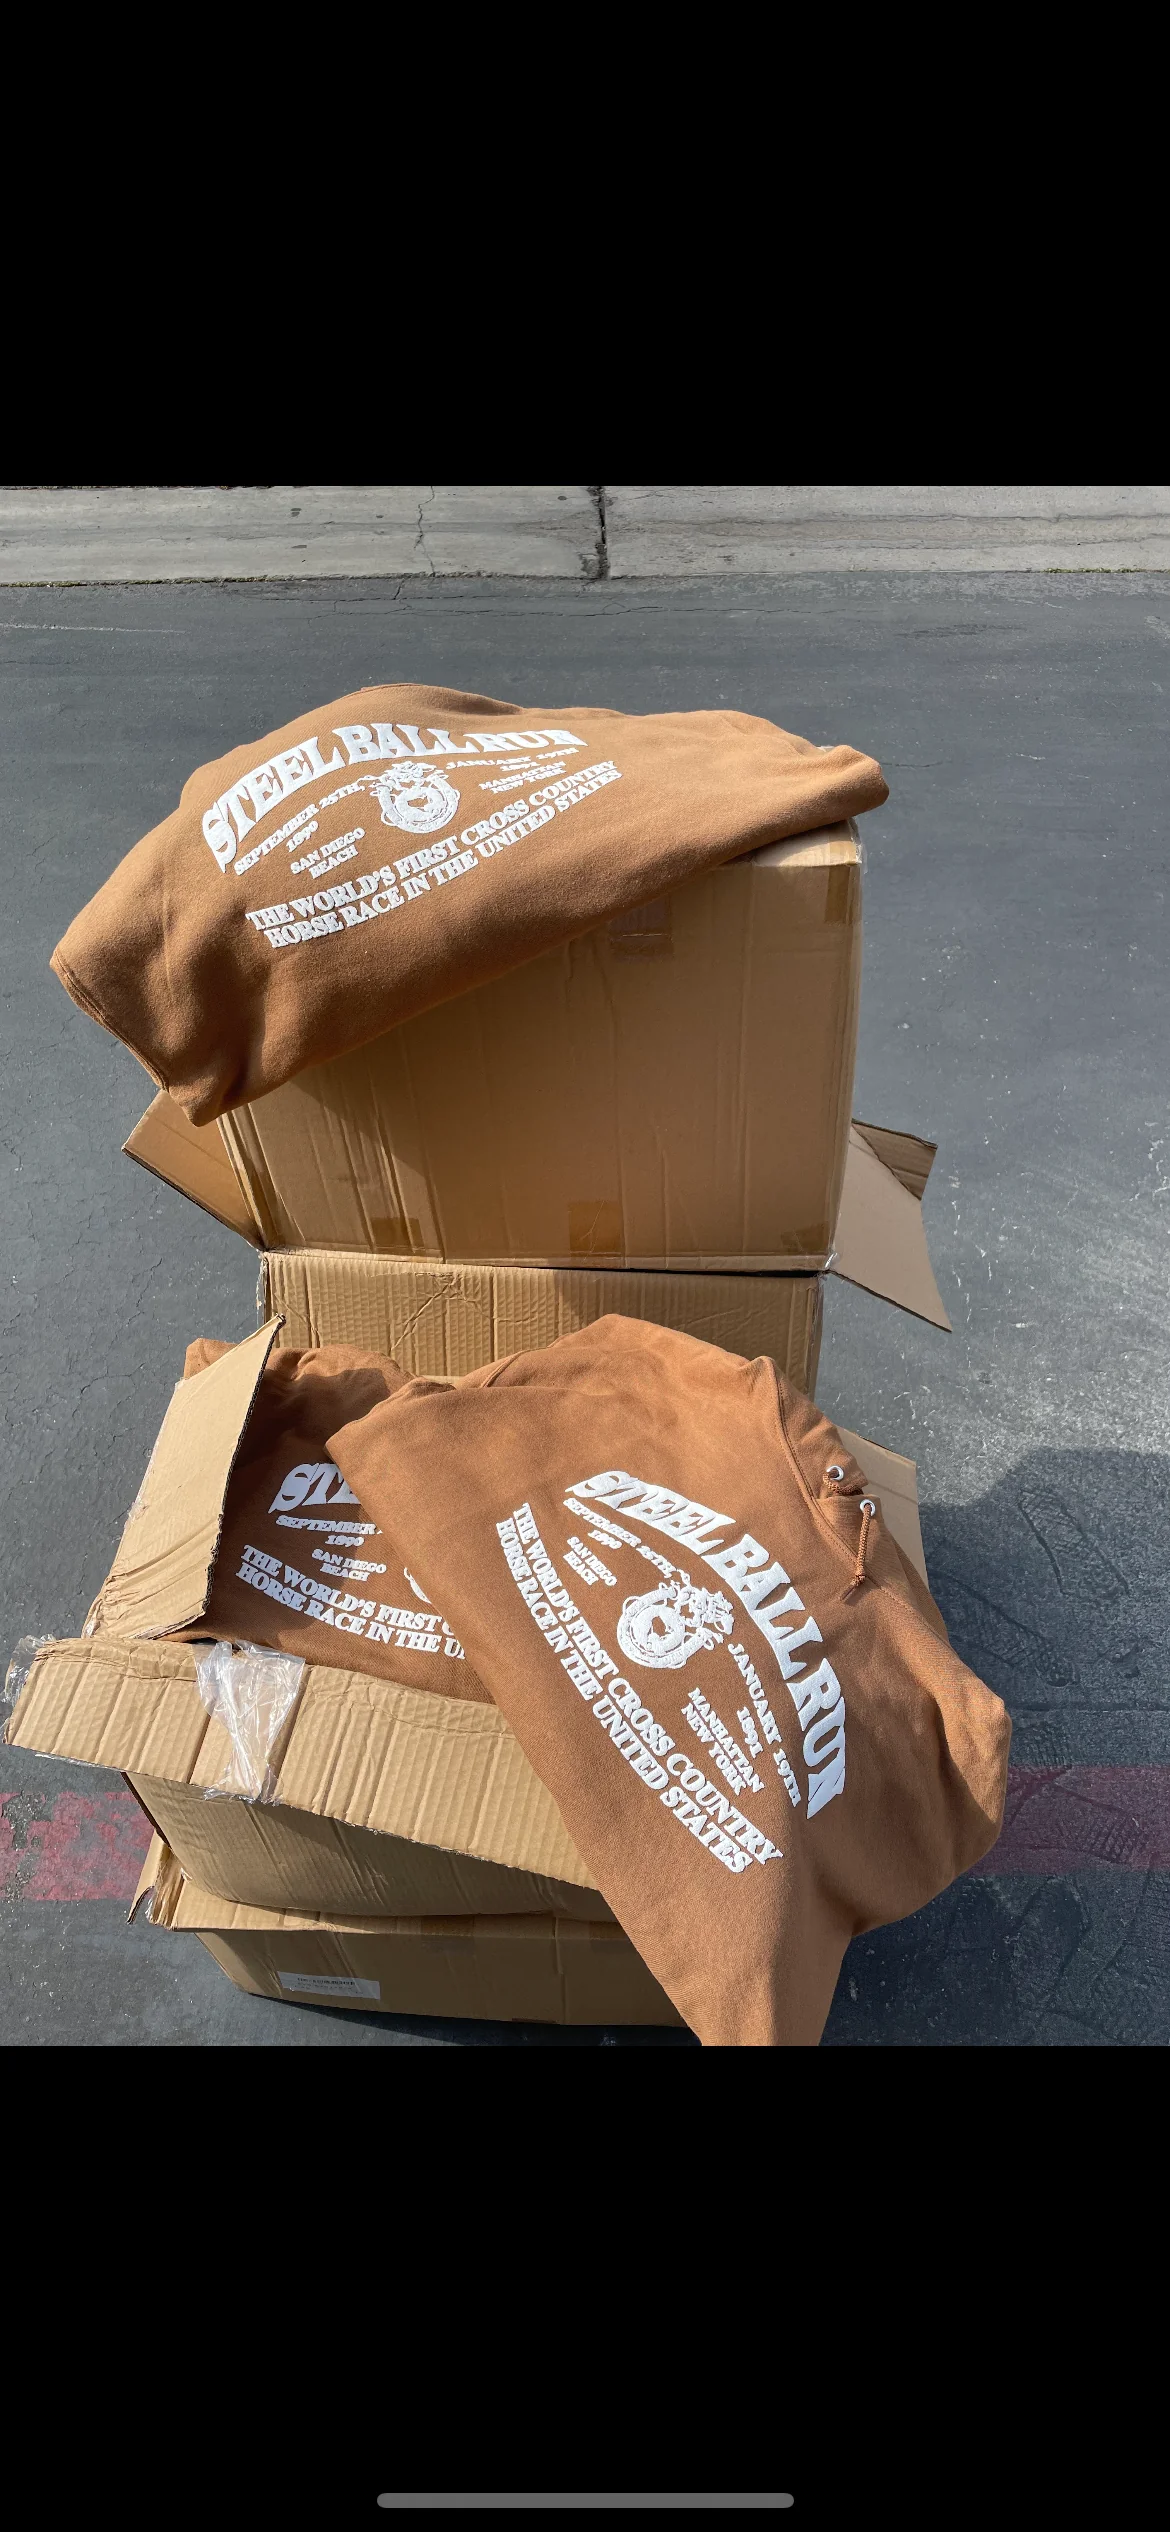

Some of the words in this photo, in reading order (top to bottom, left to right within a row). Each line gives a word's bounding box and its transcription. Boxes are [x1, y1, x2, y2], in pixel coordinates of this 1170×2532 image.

[446, 756, 531, 769] JANUARY
[479, 761, 566, 790] MANHATTAN
[490, 780, 524, 794] NEW
[525, 767, 566, 783] YORK
[202, 736, 346, 873] STEEL
[332, 723, 480, 764] BALL
[465, 730, 588, 752] RUN
[234, 804, 319, 876] SEPTEMBER
[245, 904, 294, 930] THE
[289, 865, 397, 918] WORLD'S
[393, 836, 460, 879] FIRST
[461, 799, 530, 845] CROSS
[529, 761, 617, 805] COUNTRY
[264, 912, 344, 948] HORSE
[338, 886, 405, 927] RACE
[401, 873, 432, 900] IN
[429, 850, 479, 886] THE
[475, 806, 556, 857] UNITED
[554, 770, 623, 812] STATES
[286, 820, 318, 852] 1890
[290, 850, 320, 874] SAN
[320, 827, 365, 857] DIEGO
[309, 844, 358, 879] BEACH
[276, 1515, 376, 1534] SEPTEMBER
[325, 1535, 364, 1547] 1890
[513, 1502, 540, 1544] THE
[563, 1498, 642, 1547] SEPTEMBER
[588, 1529, 622, 1549] 1890
[312, 1549, 343, 1565] SAN
[341, 1558, 387, 1574] DIEGO
[320, 1562, 370, 1581] BEACH
[526, 1539, 580, 1622] WORLD'S
[563, 1550, 599, 1585] BEACH
[567, 1536, 590, 1559] SAN
[584, 1555, 617, 1586] DIEGO
[236, 1562, 309, 1612] HORSE
[304, 1599, 366, 1636] RACE
[365, 1621, 398, 1645] IN
[395, 1629, 442, 1653] THE
[241, 1544, 283, 1576] THE
[283, 1565, 377, 1618] WORLD'S
[377, 1604, 443, 1632] FIRST
[565, 1470, 737, 1555] STEEL
[703, 1533, 823, 1680] BALL
[786, 1658, 845, 1820] RUN
[566, 1617, 619, 1679] FIRST
[496, 1518, 533, 1581] HORSE
[517, 1577, 559, 1630] RACE
[544, 1626, 574, 1653] IN
[560, 1649, 604, 1700] THE
[592, 1695, 669, 1790] UNITED
[660, 1786, 753, 1873] STATES
[608, 1678, 675, 1756] CROSS
[681, 1703, 715, 1743] NEW
[708, 1742, 746, 1796] YORK
[688, 1687, 765, 1793] MANHATTAN
[728, 1643, 783, 1745] JANUARY
[773, 1748, 801, 1807] 19TH
[737, 1707, 763, 1758] 1891
[667, 1753, 783, 1865] COUNTRY
